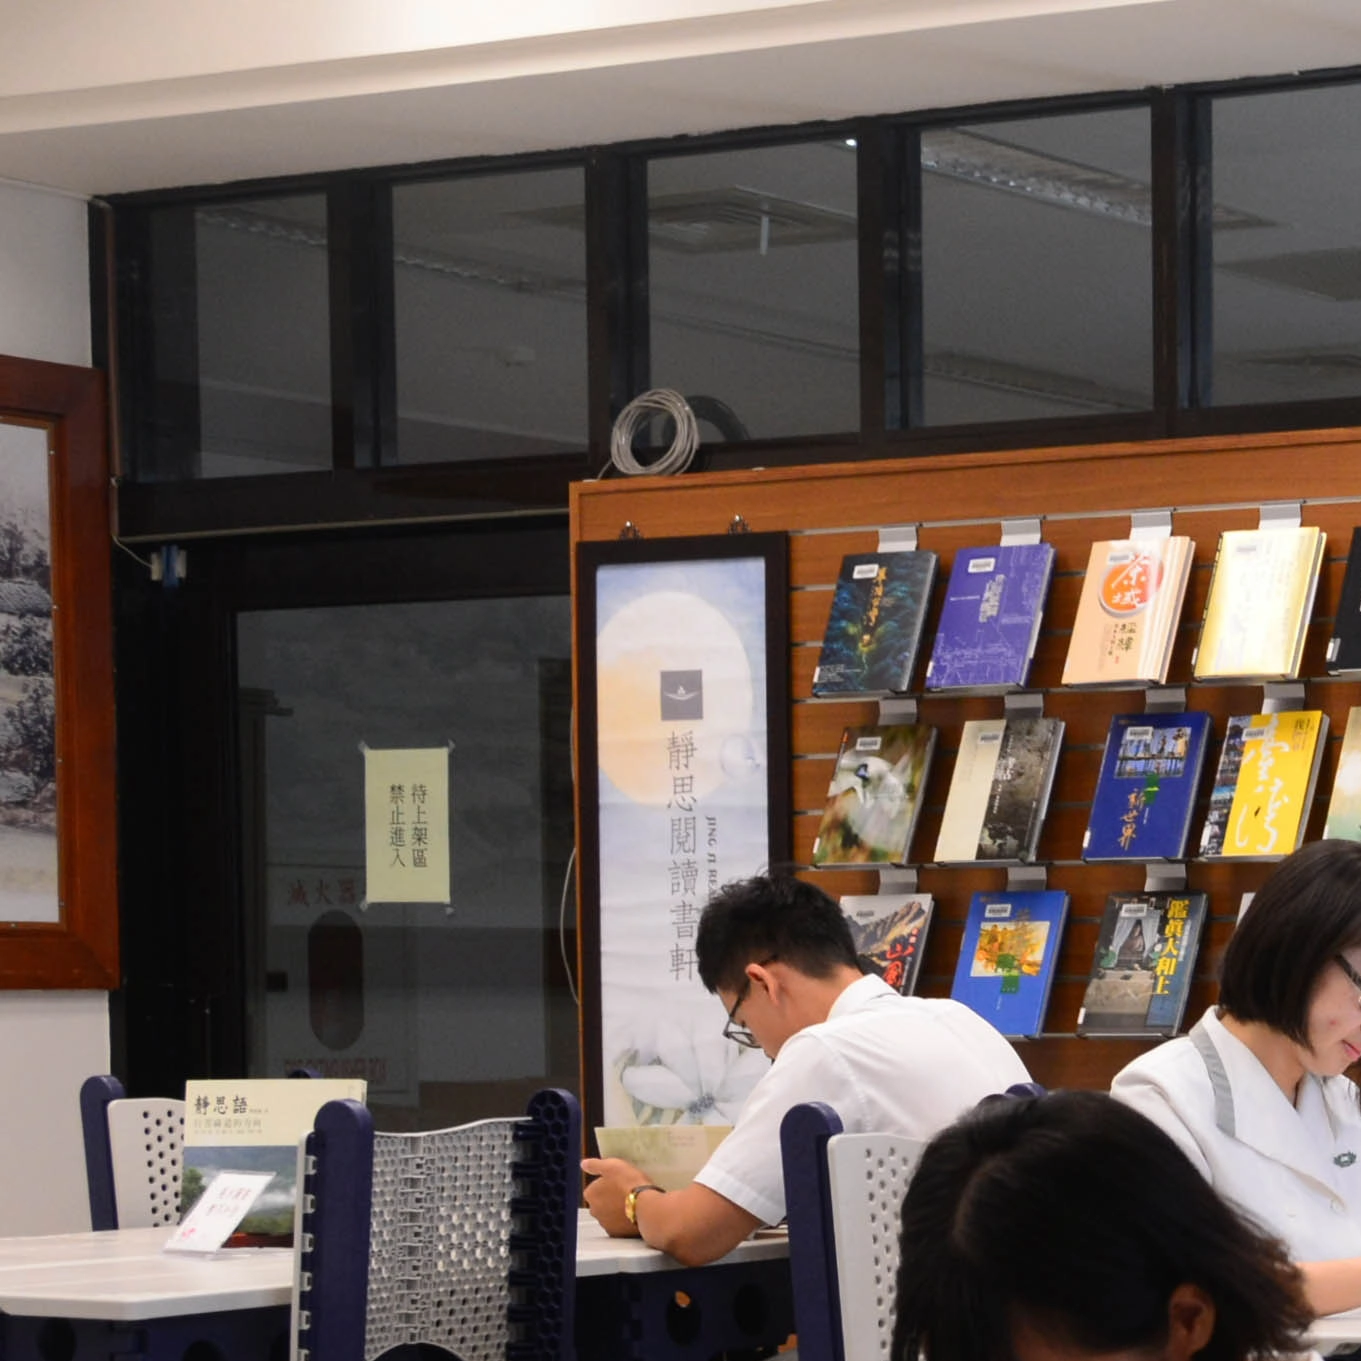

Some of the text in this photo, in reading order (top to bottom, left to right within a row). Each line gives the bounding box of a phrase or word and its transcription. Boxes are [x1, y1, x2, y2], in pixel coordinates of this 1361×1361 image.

[389, 783, 406, 869] 禁止進入
[411, 783, 428, 869] 待上架區
[666, 730, 700, 983] 靜思閱讀書軒
[705, 815, 717, 847] JING
[195, 1095, 248, 1115] 靜思語
